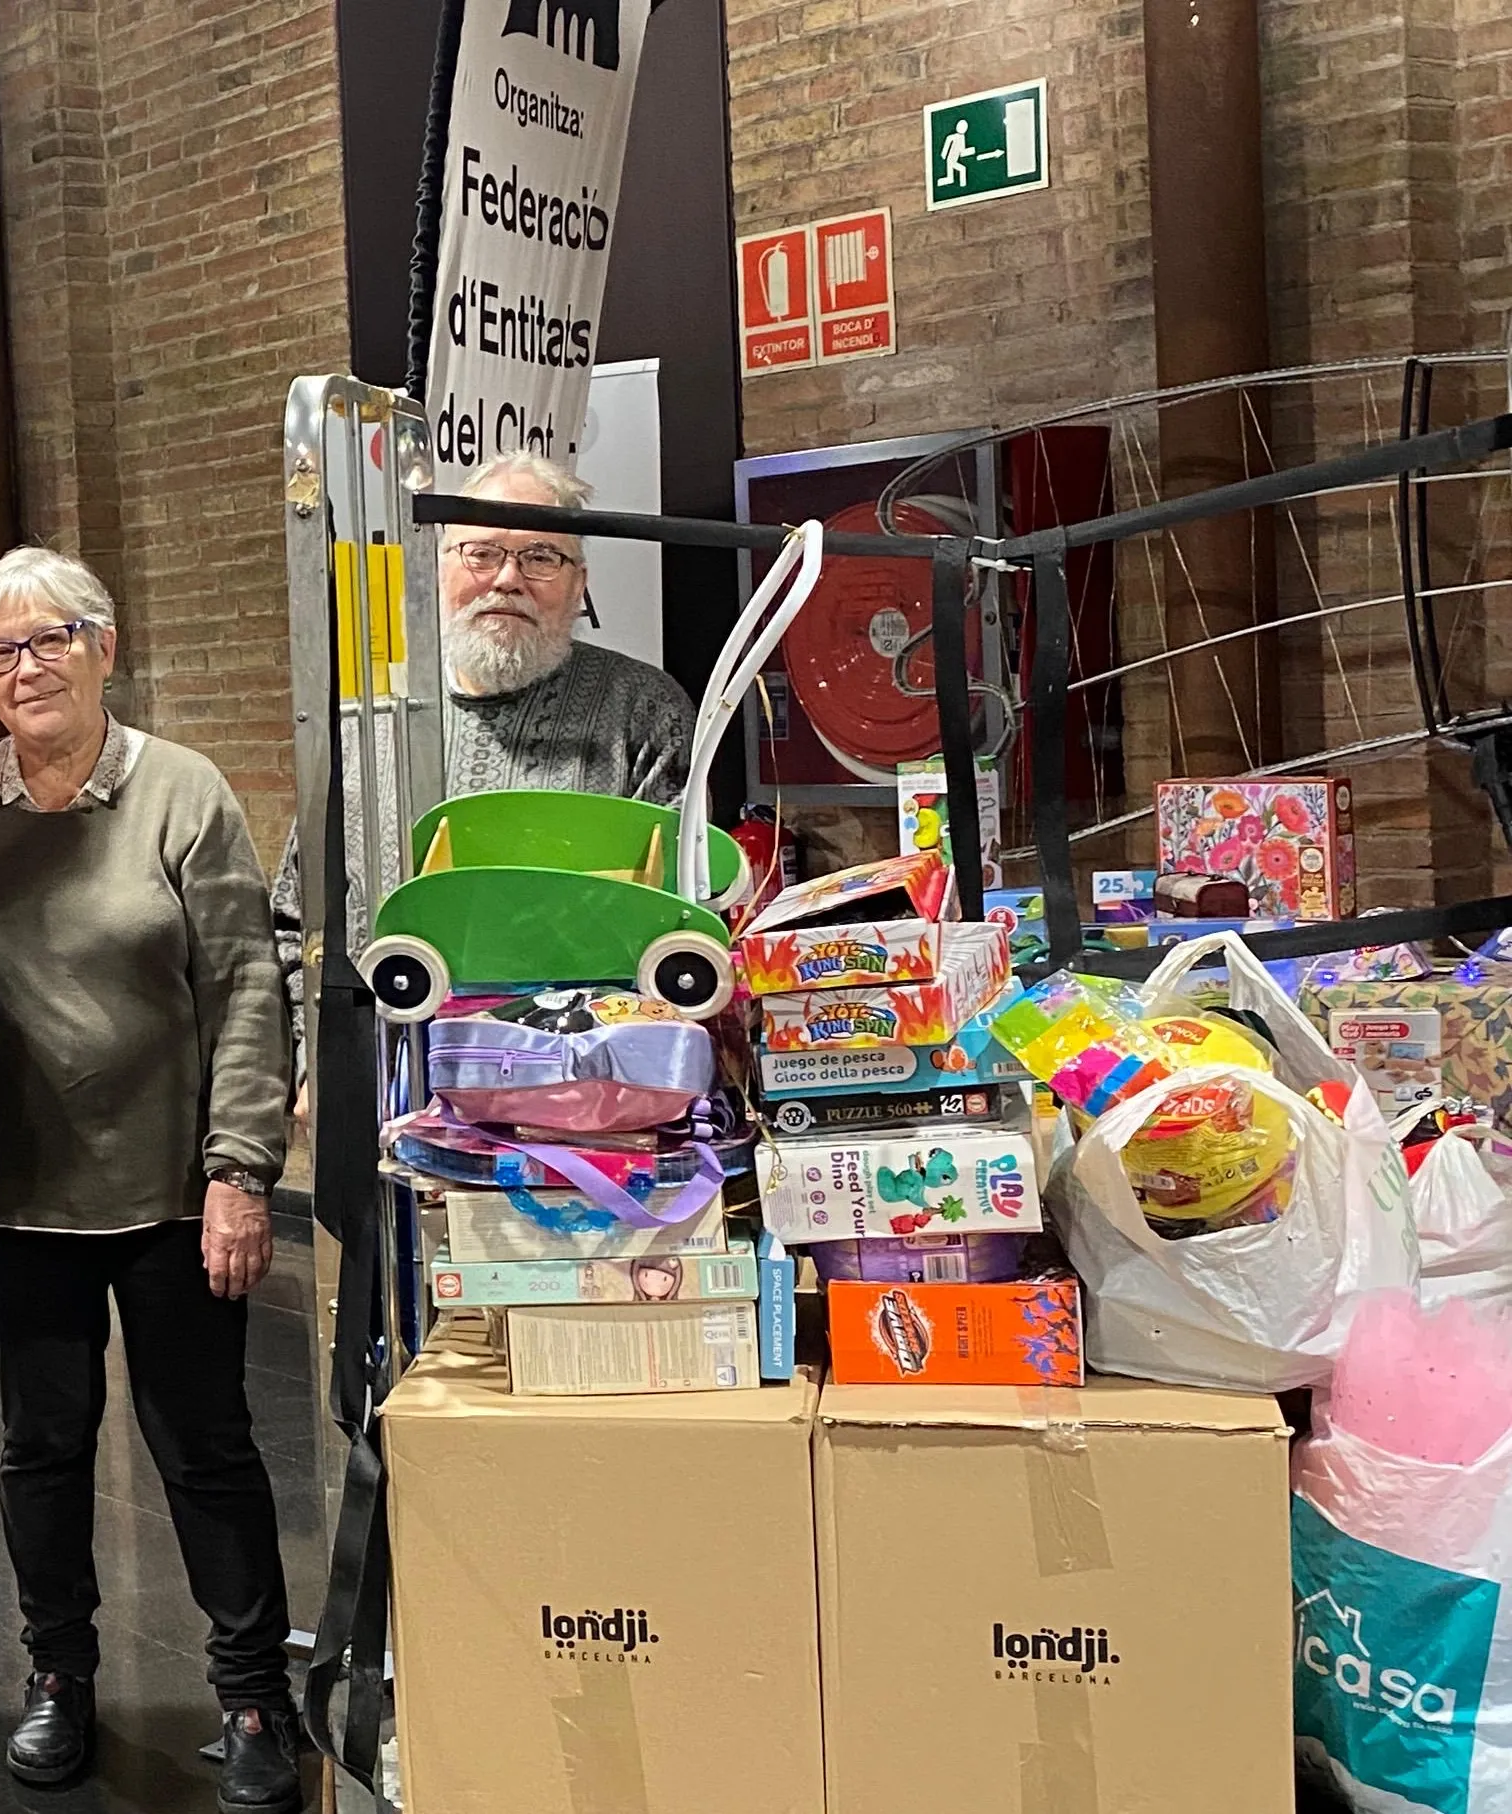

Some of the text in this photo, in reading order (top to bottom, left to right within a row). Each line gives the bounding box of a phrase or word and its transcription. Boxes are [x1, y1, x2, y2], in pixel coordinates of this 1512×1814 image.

[494, 67, 584, 139] Organitza:
[462, 145, 610, 250] Federació
[832, 320, 862, 335] BOCA
[752, 337, 806, 357] EXTINTOR
[437, 392, 484, 467] del
[1098, 877, 1124, 894] 25
[797, 954, 887, 983] KING SPIN
[806, 1017, 896, 1042] KING SPIN
[773, 1052, 886, 1070] Juego de pesca
[774, 1065, 905, 1083] Gioco della pesca
[826, 1102, 913, 1121] PUZZLE 560
[830, 1152, 846, 1190] Dino
[846, 1151, 867, 1238] Feed Your
[976, 1159, 994, 1215] CREATIVE
[989, 1154, 1025, 1219] PLAY
[528, 1281, 561, 1291] 200
[772, 1268, 783, 1368] SPACE PLACEMENT
[544, 1650, 651, 1664] BARCELONA
[994, 1670, 1111, 1686] BARCELONA
